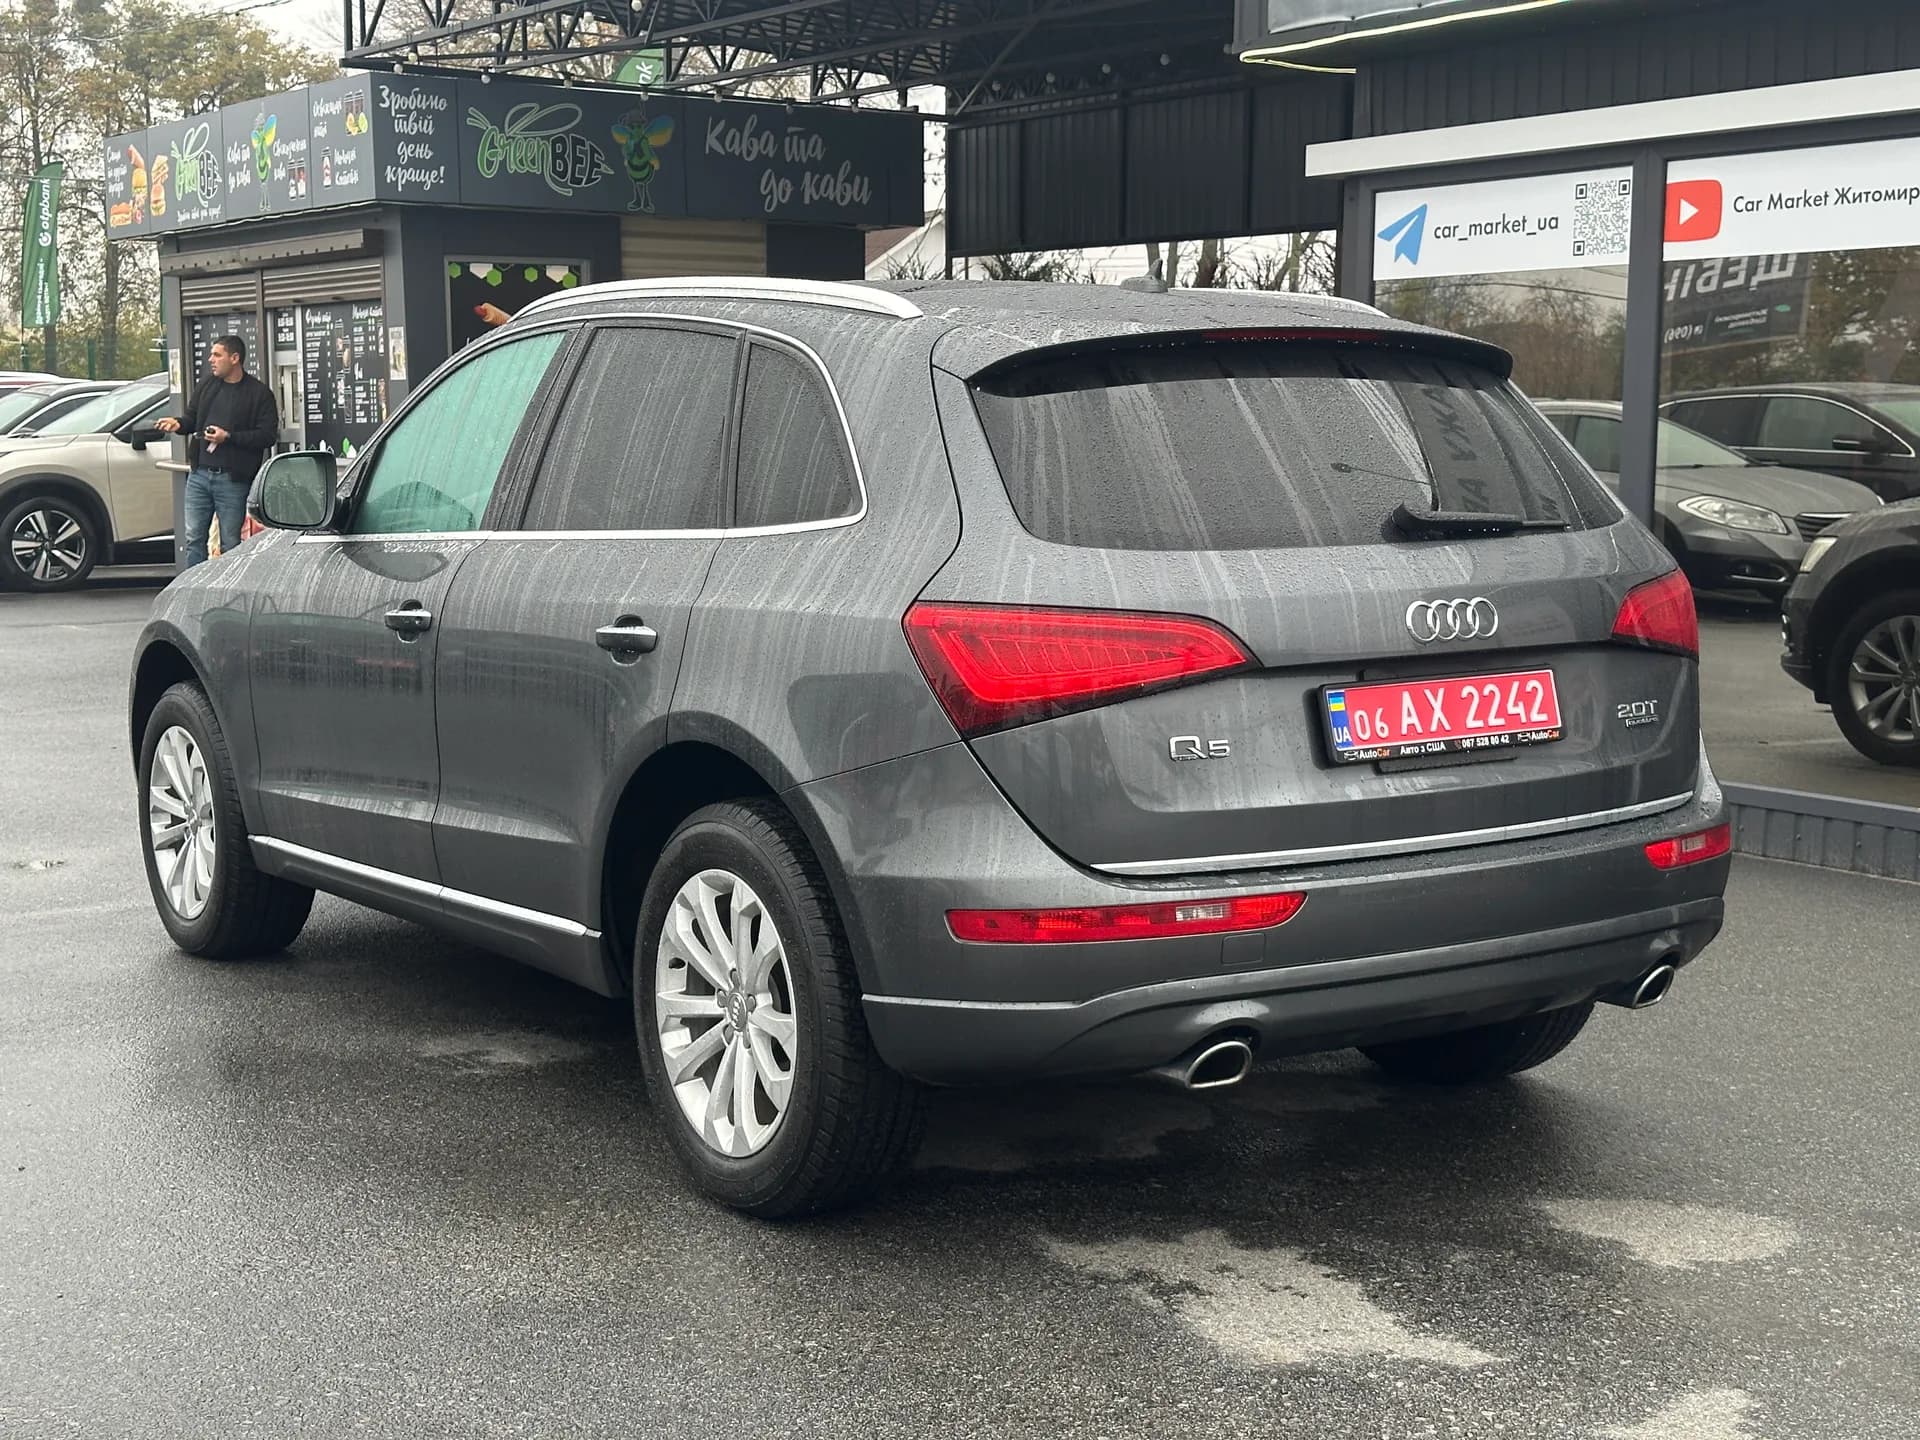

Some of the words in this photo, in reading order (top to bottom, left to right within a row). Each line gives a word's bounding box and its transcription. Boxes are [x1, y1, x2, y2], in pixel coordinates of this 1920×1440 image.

[379, 85, 448, 116] Зробимо
[394, 111, 435, 136] твій
[705, 114, 778, 161] Кава
[784, 127, 826, 163] та
[397, 141, 433, 165] день
[385, 165, 445, 192] краще!
[760, 168, 793, 213] до
[801, 161, 872, 206] кави
[1733, 195, 1763, 214] Car
[1767, 189, 1829, 211] Market
[1834, 185, 1920, 206] Житомир
[1434, 213, 1559, 241] car_market_ua
[1353, 707, 1390, 741] 06
[1400, 687, 1451, 736] AX
[1460, 679, 1549, 729] 2242
[1334, 726, 1352, 744] UA
[1400, 744, 1420, 755] Авто
[1426, 740, 1446, 752] США
[1500, 734, 1511, 744] 42
[1531, 729, 1561, 741] AutoCar
[1359, 747, 1391, 760] AutoCar
